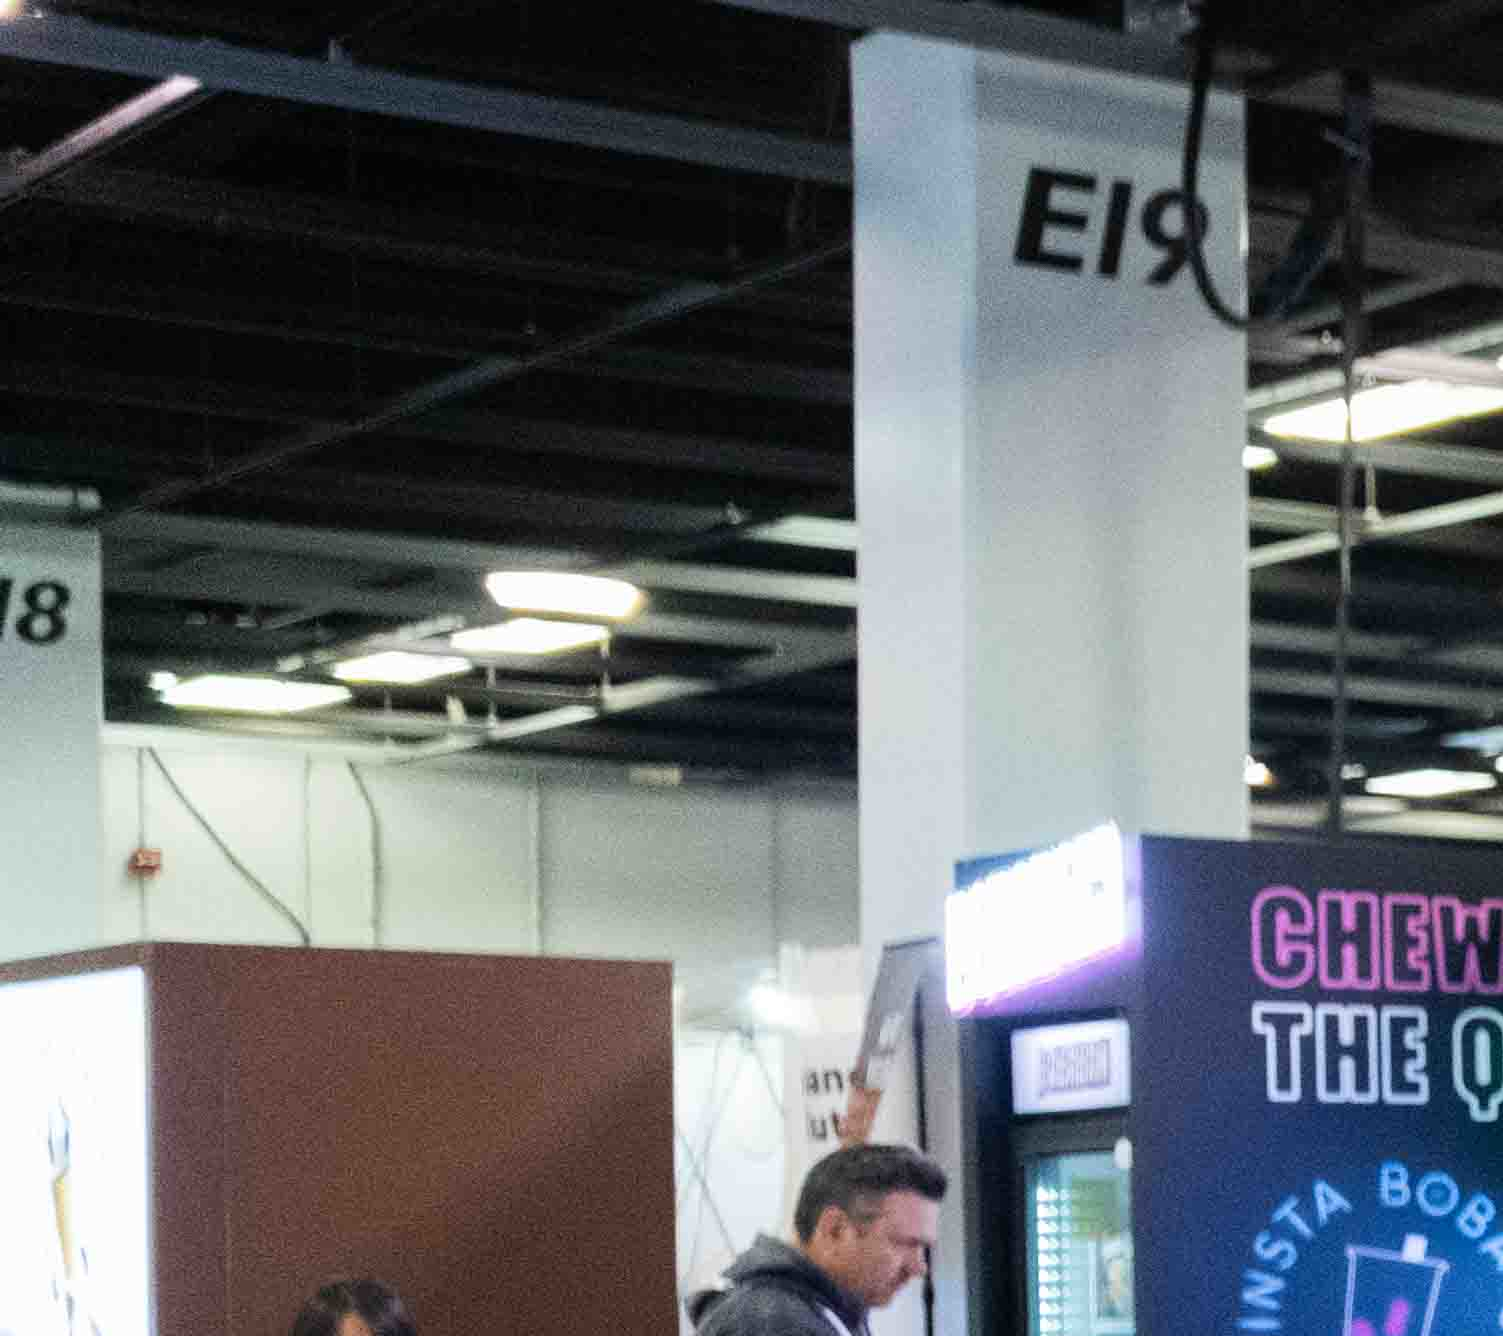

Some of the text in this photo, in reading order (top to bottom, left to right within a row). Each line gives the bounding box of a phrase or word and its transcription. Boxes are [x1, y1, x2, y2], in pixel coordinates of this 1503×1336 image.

[1014, 168, 1208, 286] E19
[1251, 1001, 1430, 1105] THE
[1236, 1178, 1353, 1331] INSTA
